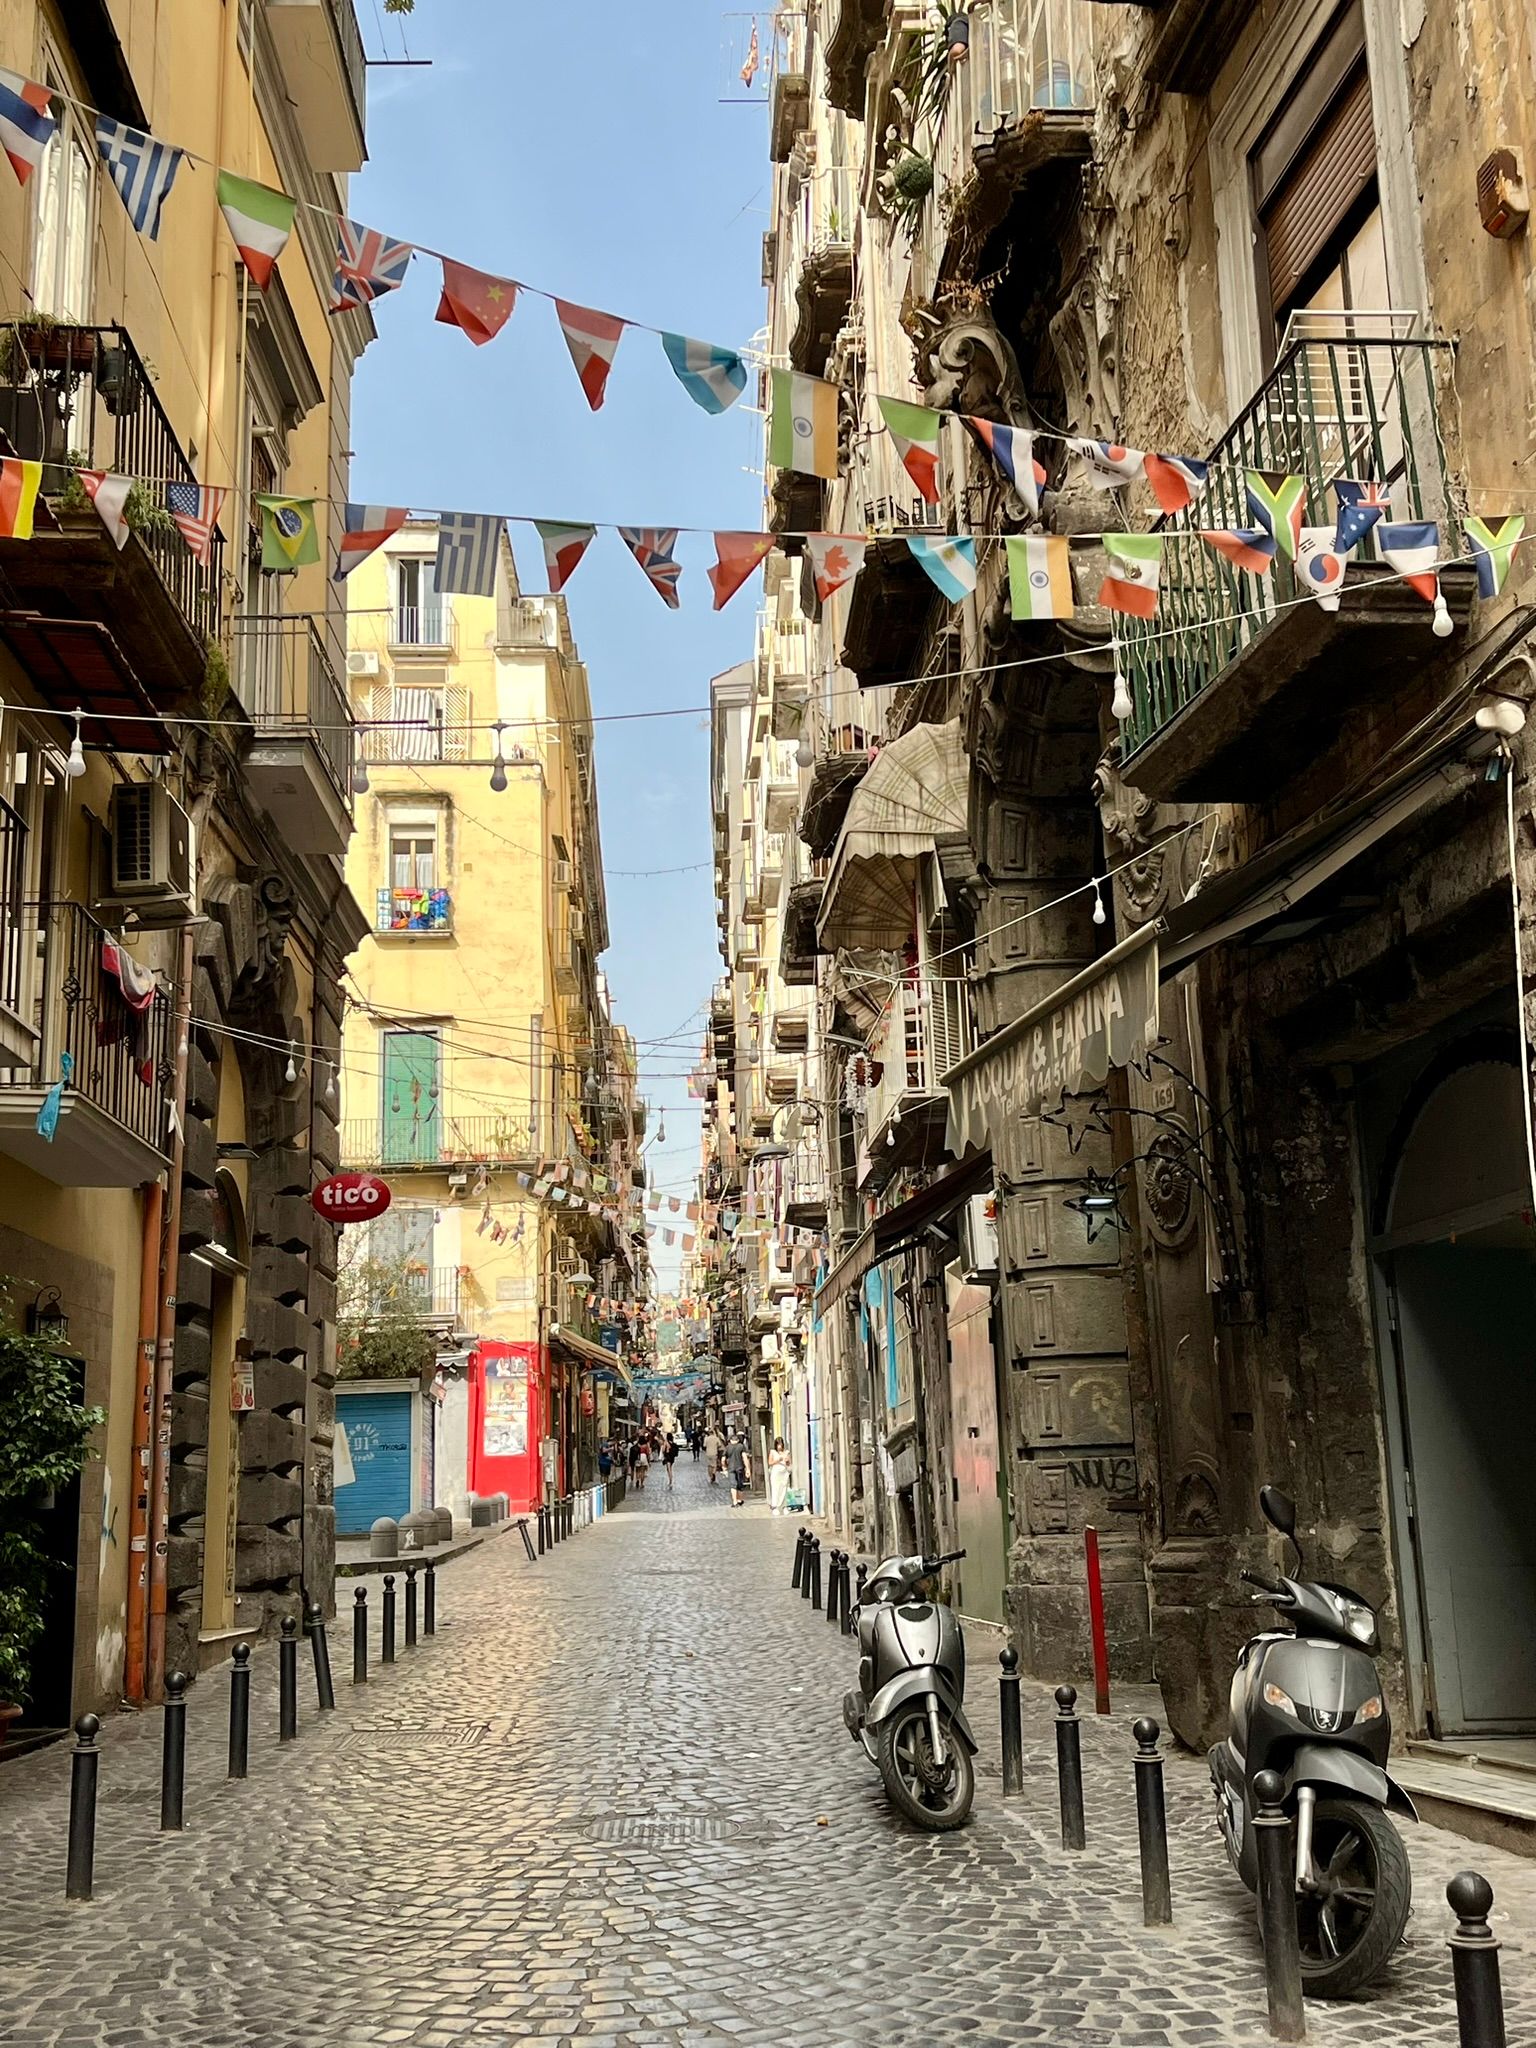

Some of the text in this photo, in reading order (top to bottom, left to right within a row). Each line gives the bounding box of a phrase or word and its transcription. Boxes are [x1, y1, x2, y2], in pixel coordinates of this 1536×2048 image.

[1032, 1026, 1047, 1071] &
[1052, 972, 1125, 1059] FARINA
[321, 1182, 379, 1206] tico
